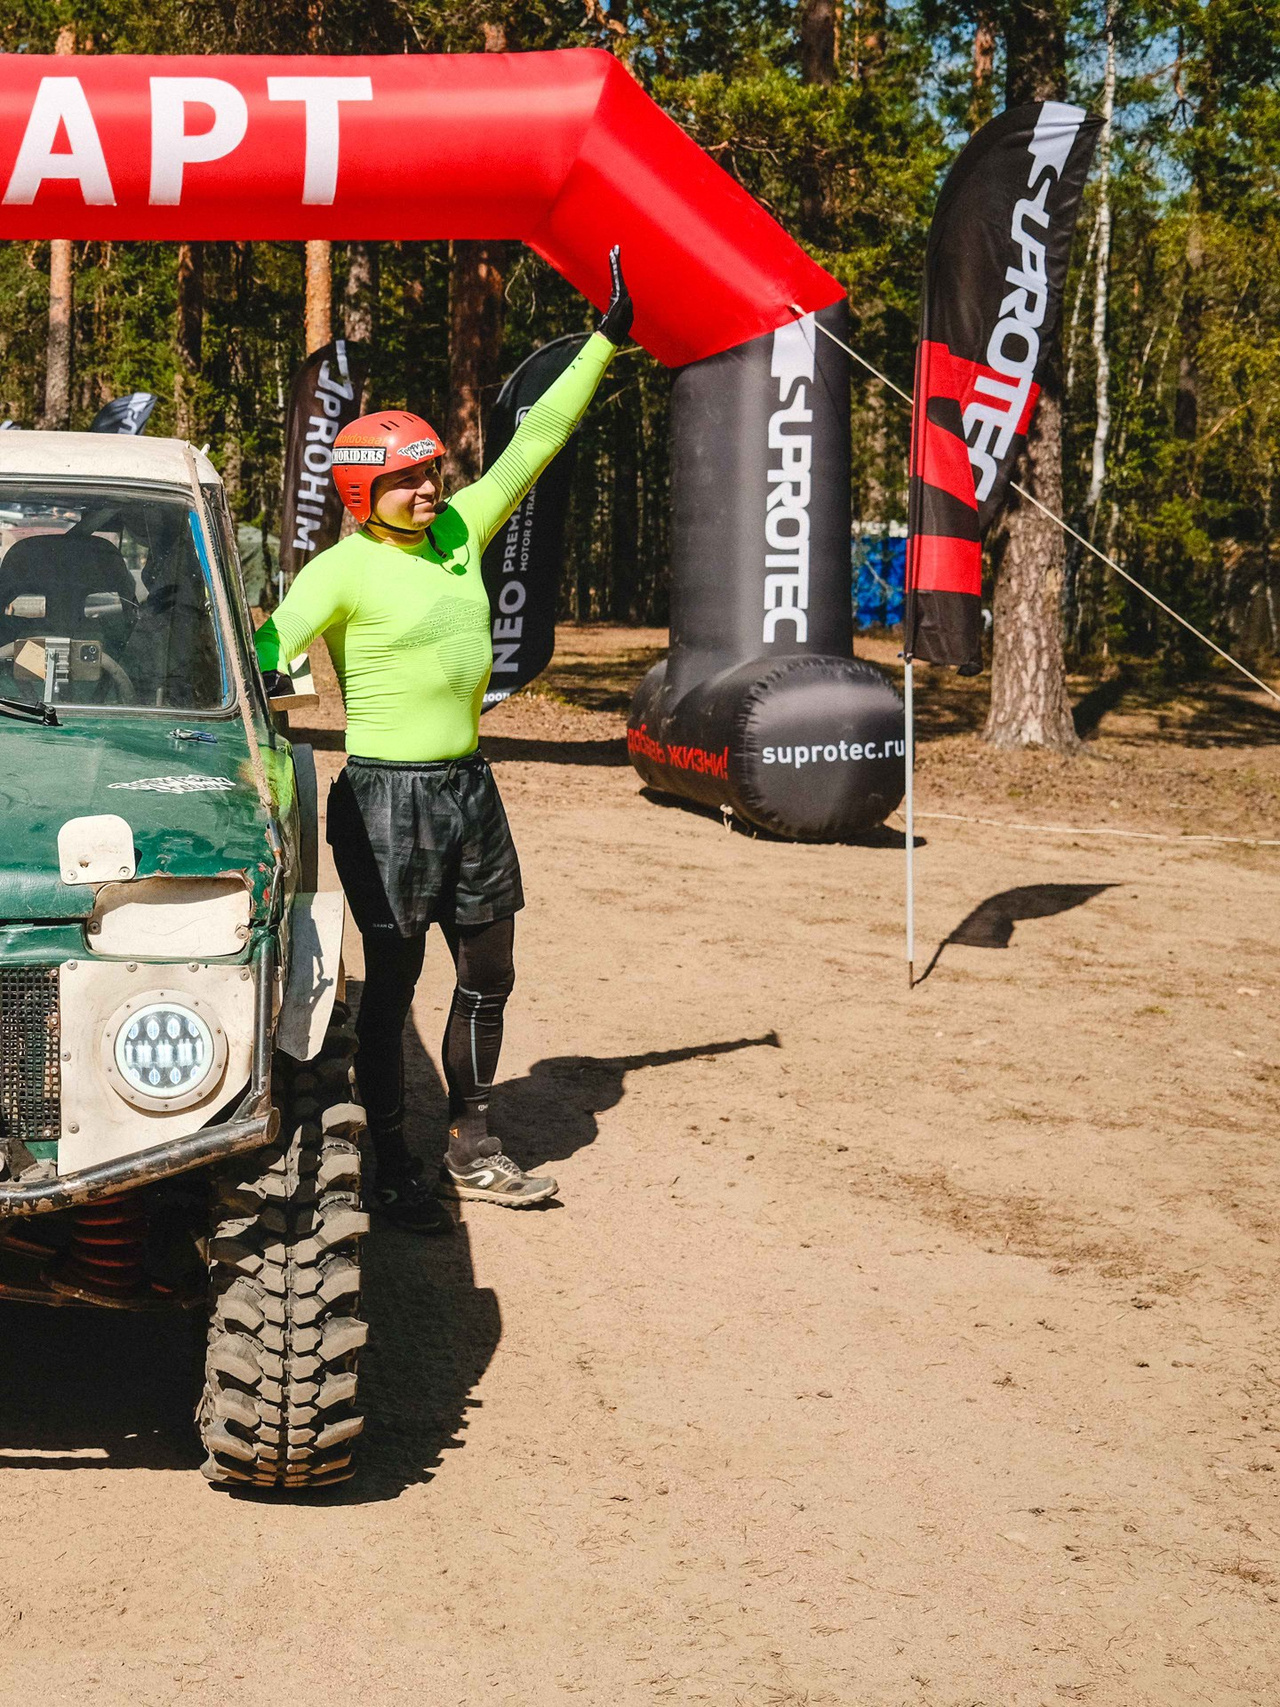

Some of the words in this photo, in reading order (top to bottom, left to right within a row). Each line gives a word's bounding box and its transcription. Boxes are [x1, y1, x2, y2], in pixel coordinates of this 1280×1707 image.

[962, 102, 1087, 502] SUPROTEC
[763, 312, 815, 643] SUPROTEC
[520, 529, 531, 571] MOTOR
[524, 519, 533, 527] &
[492, 580, 526, 673] NEO
[762, 739, 905, 769] suprotec.ru
